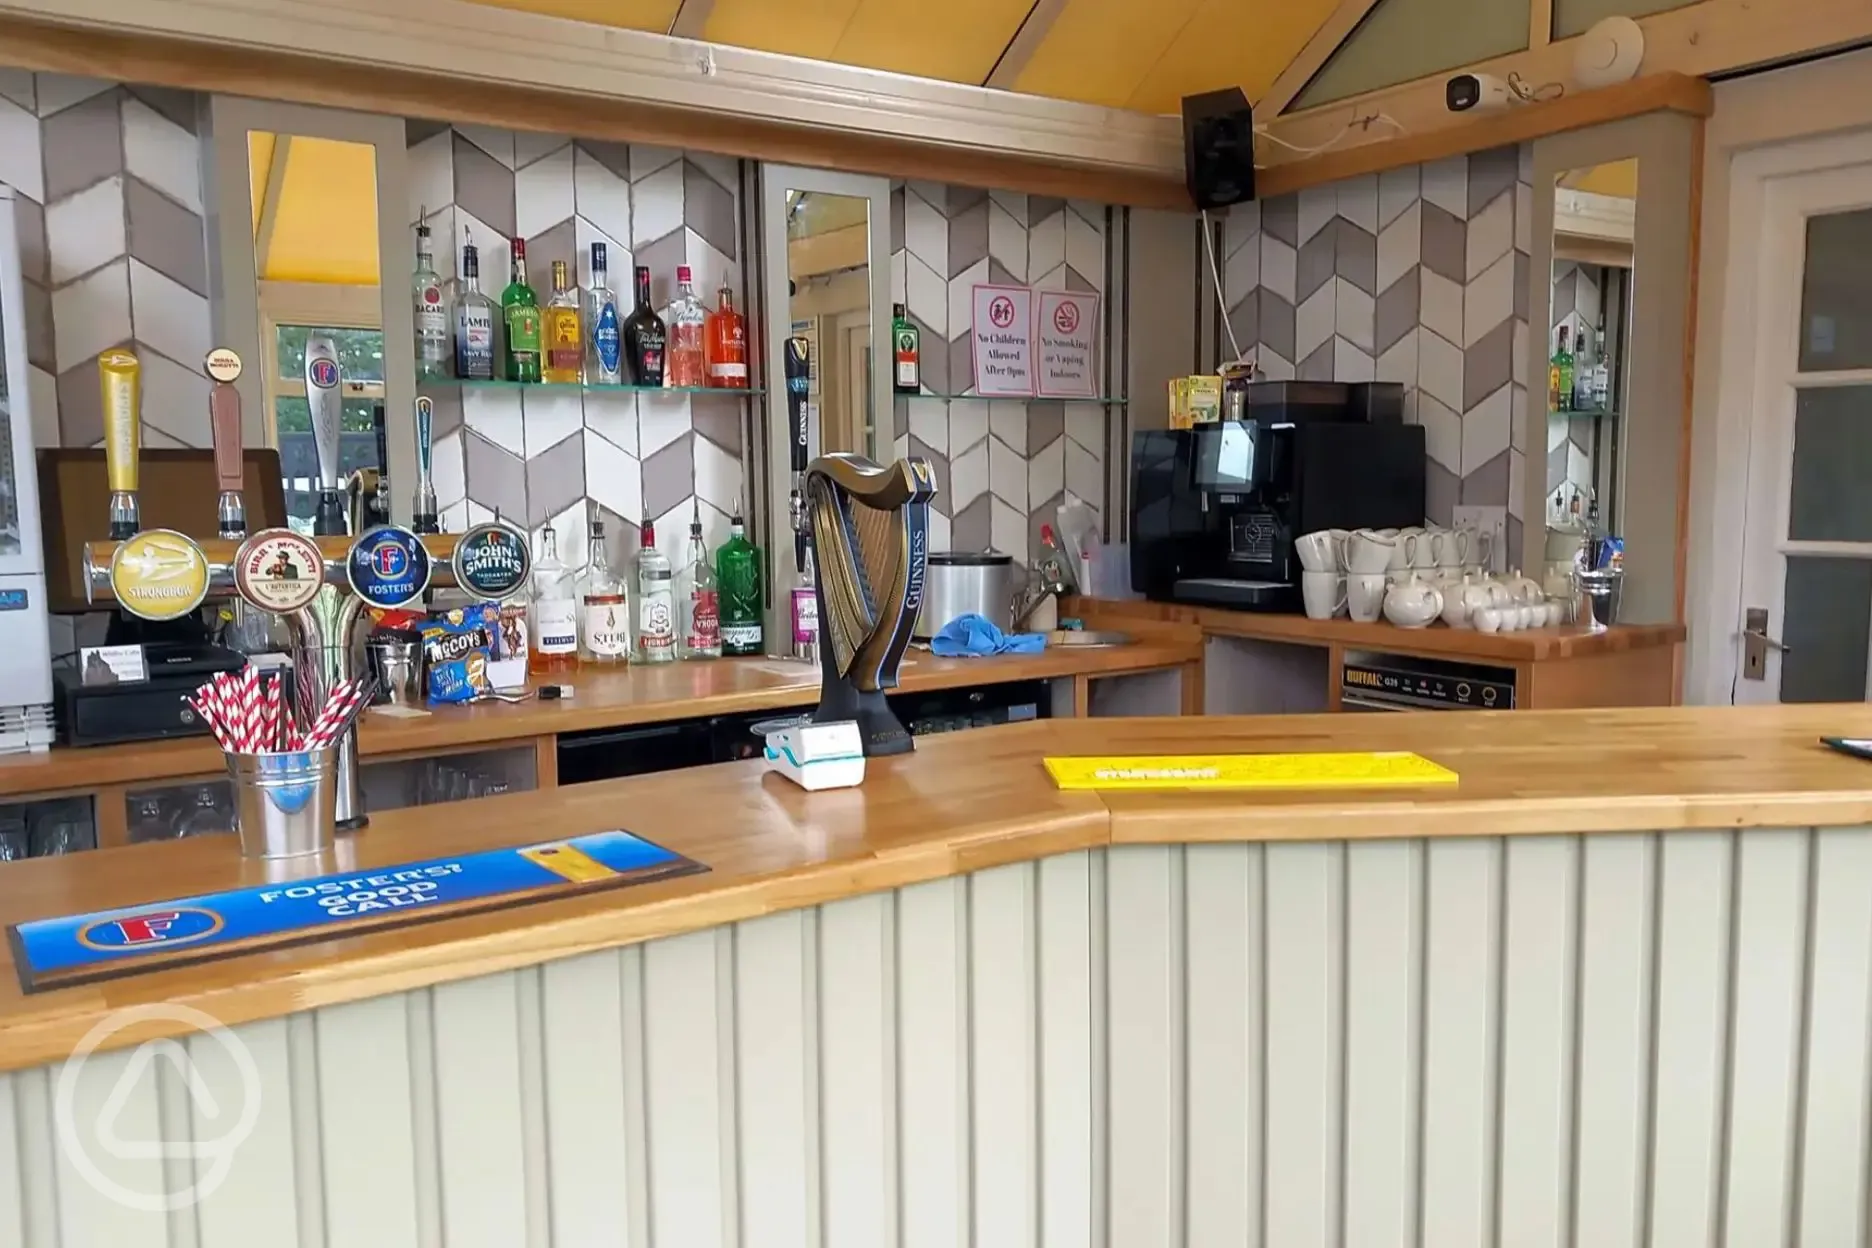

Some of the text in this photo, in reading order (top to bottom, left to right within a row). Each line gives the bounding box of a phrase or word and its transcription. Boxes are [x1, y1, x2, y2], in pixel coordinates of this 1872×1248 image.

[977, 333, 1026, 345] No Children
[1041, 336, 1088, 350] No Smoking
[988, 349, 1020, 360] Allowed
[1055, 354, 1084, 366] Vaping
[985, 365, 1005, 375] After
[1049, 369, 1081, 379] Indoors
[472, 544, 513, 561] JOHN
[465, 556, 522, 576] SMITH'S
[905, 529, 925, 610] GUINNESS
[127, 583, 193, 600] STRONGBOW
[318, 881, 438, 907] GOOD
[326, 893, 439, 916] CALL
[112, 911, 180, 945] F
